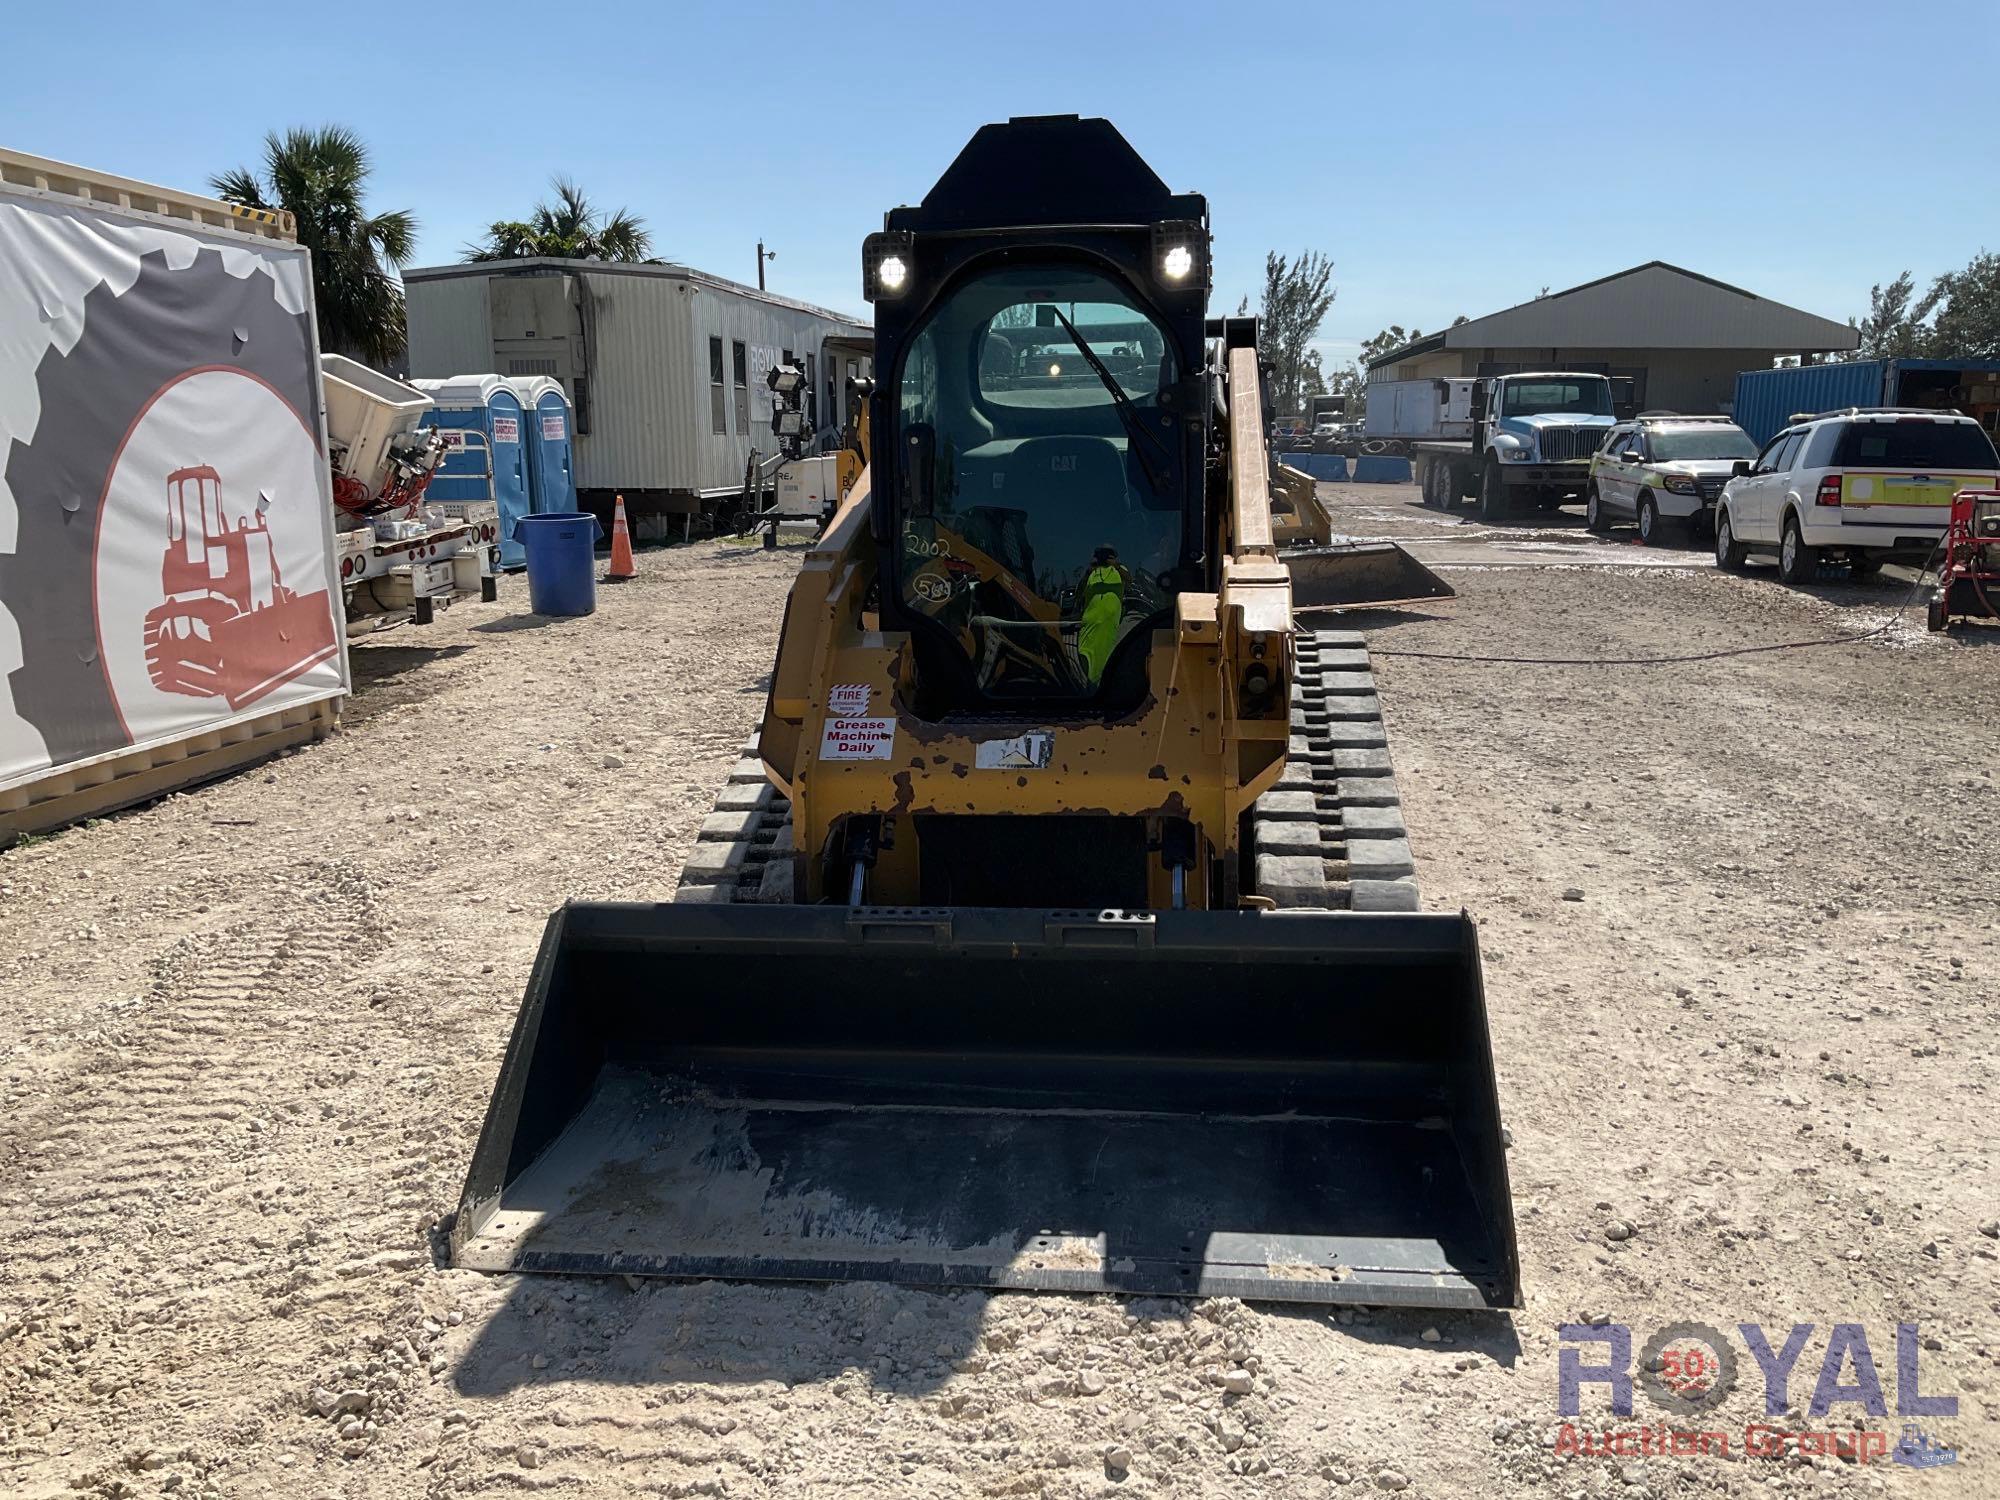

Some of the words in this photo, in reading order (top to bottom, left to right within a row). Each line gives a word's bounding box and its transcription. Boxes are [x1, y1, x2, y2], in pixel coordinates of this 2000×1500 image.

[904, 534, 952, 558] 2002
[837, 690, 862, 700] FIRE
[834, 720, 886, 730] Grease
[838, 742, 880, 754] Daily
